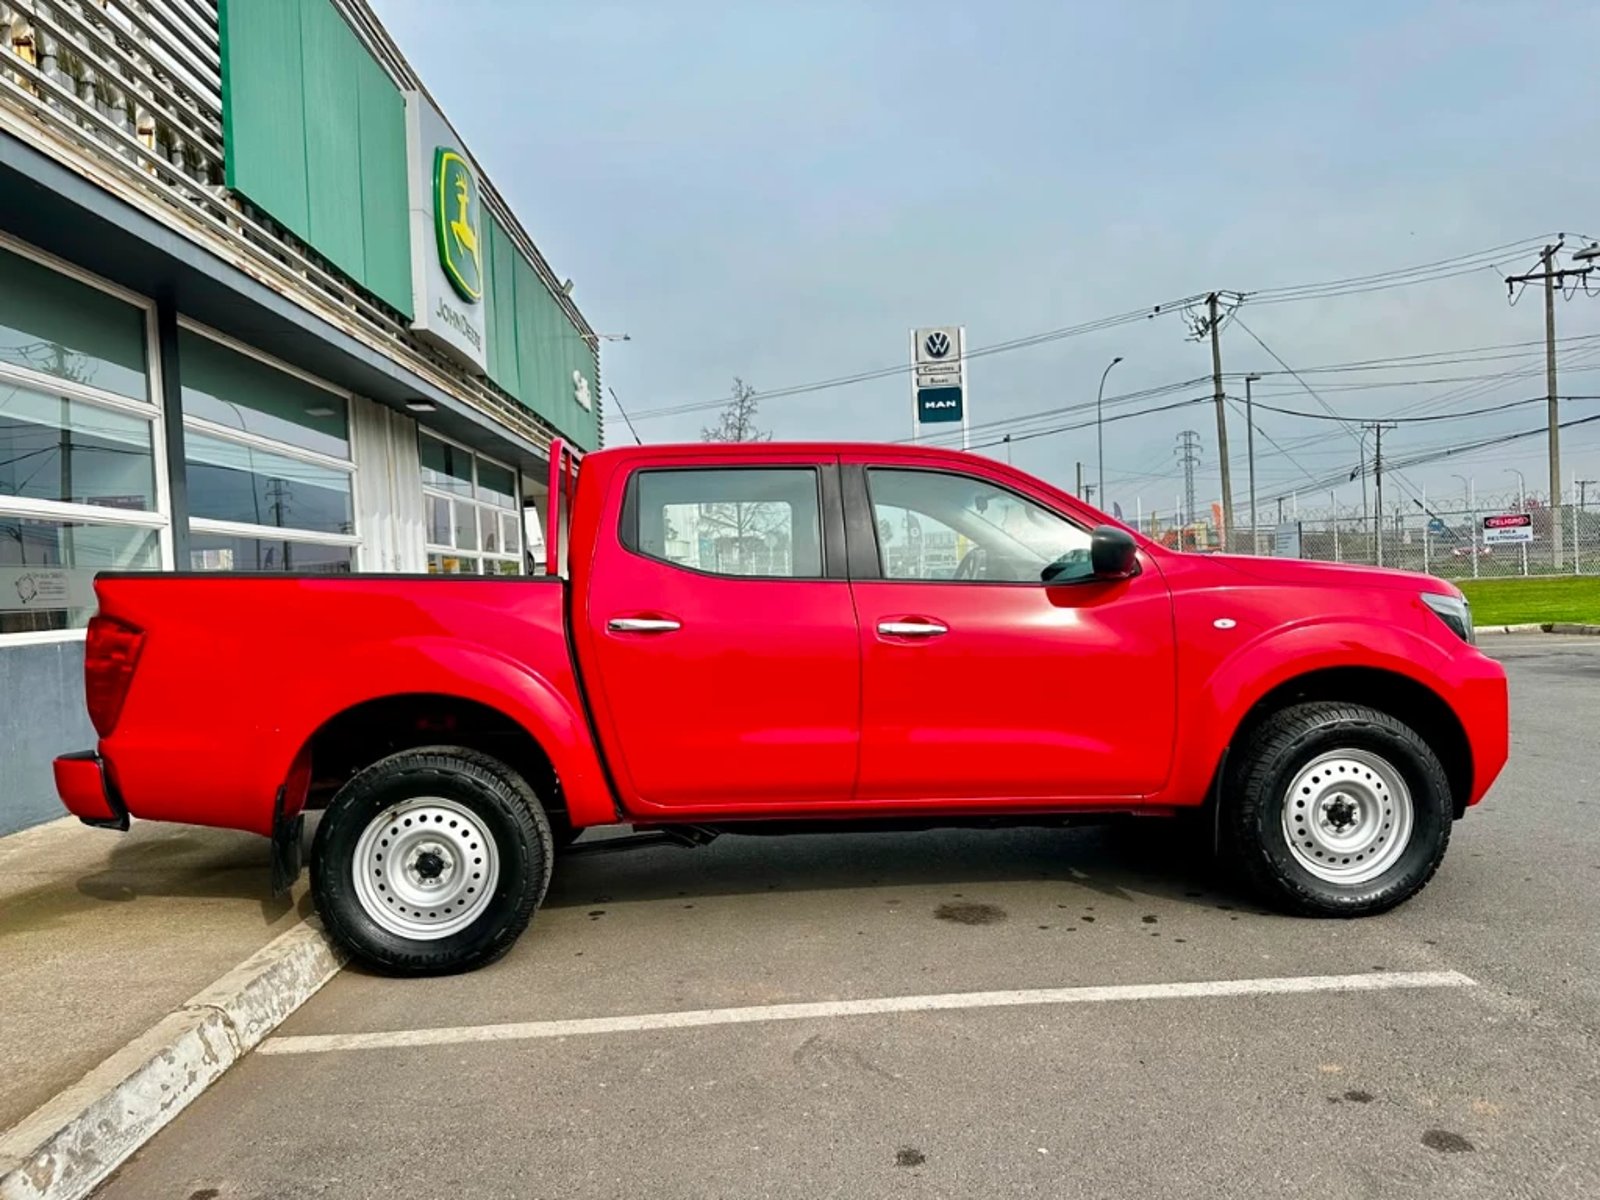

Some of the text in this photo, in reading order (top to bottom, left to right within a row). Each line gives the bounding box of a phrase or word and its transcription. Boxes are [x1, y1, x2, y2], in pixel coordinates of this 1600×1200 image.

[436, 297, 481, 352] JOHN DEERE
[925, 400, 956, 409] MAN
[1489, 518, 1525, 527] PELIGRO
